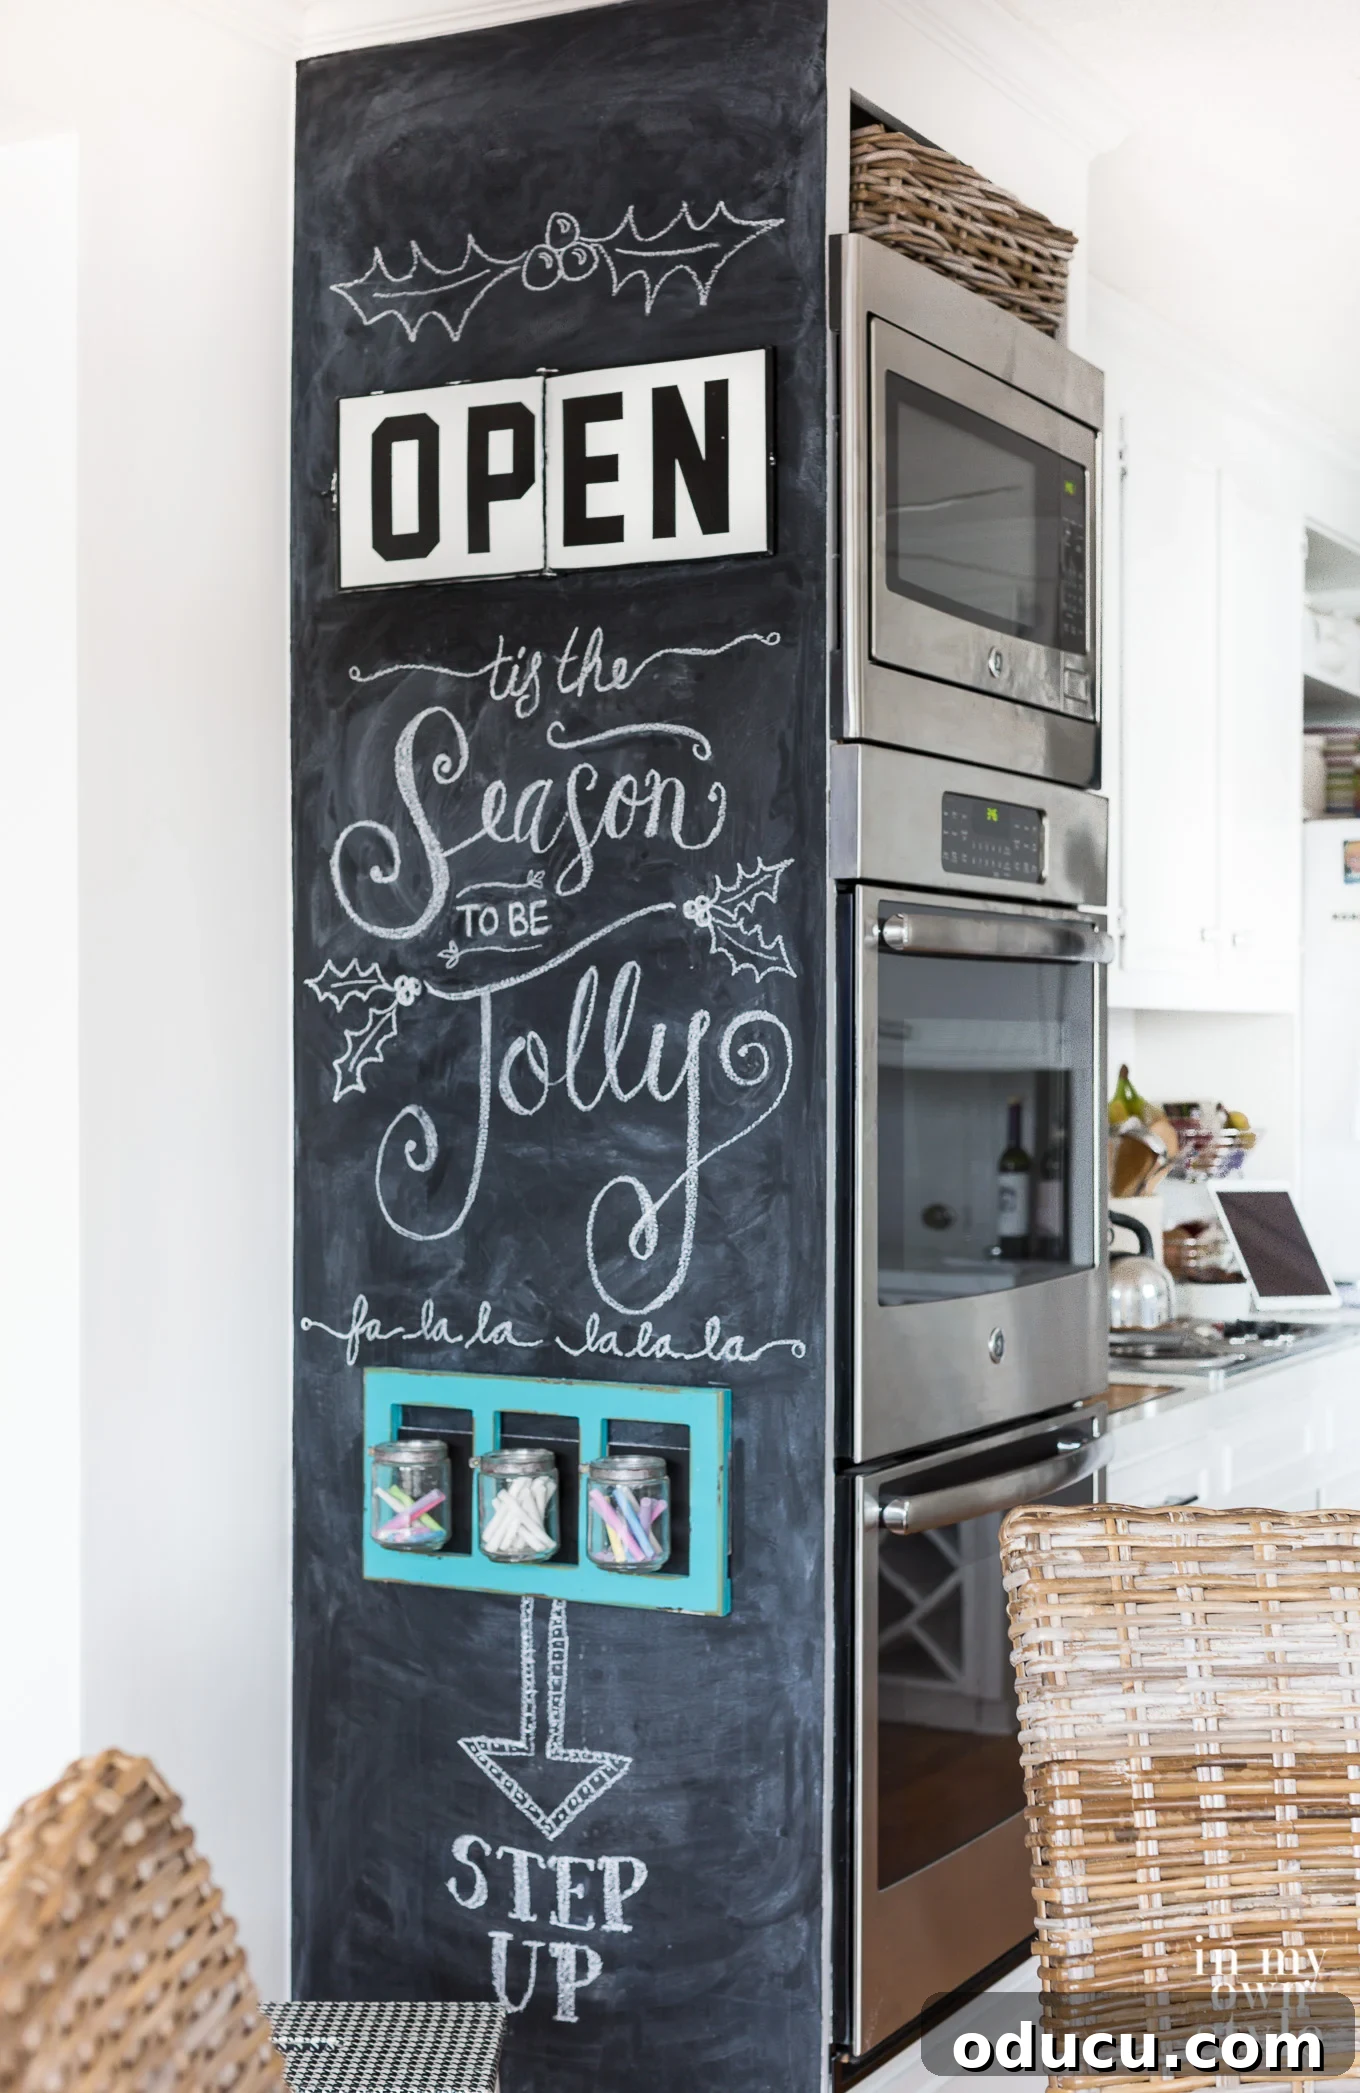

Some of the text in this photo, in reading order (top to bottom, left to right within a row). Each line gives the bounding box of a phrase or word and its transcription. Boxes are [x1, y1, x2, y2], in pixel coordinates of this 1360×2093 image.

[371, 378, 730, 562] OPEN
[488, 625, 632, 719] tis the
[330, 706, 727, 940] Season
[456, 899, 552, 938] TO BE
[376, 945, 794, 1315] Jolly
[405, 1299, 463, 1343] la
[466, 1300, 540, 1348] la
[564, 1312, 624, 1356] la
[625, 1320, 682, 1358] la
[688, 1315, 764, 1362] la
[446, 1834, 649, 1933] STEP
[488, 1931, 604, 2023] UP
